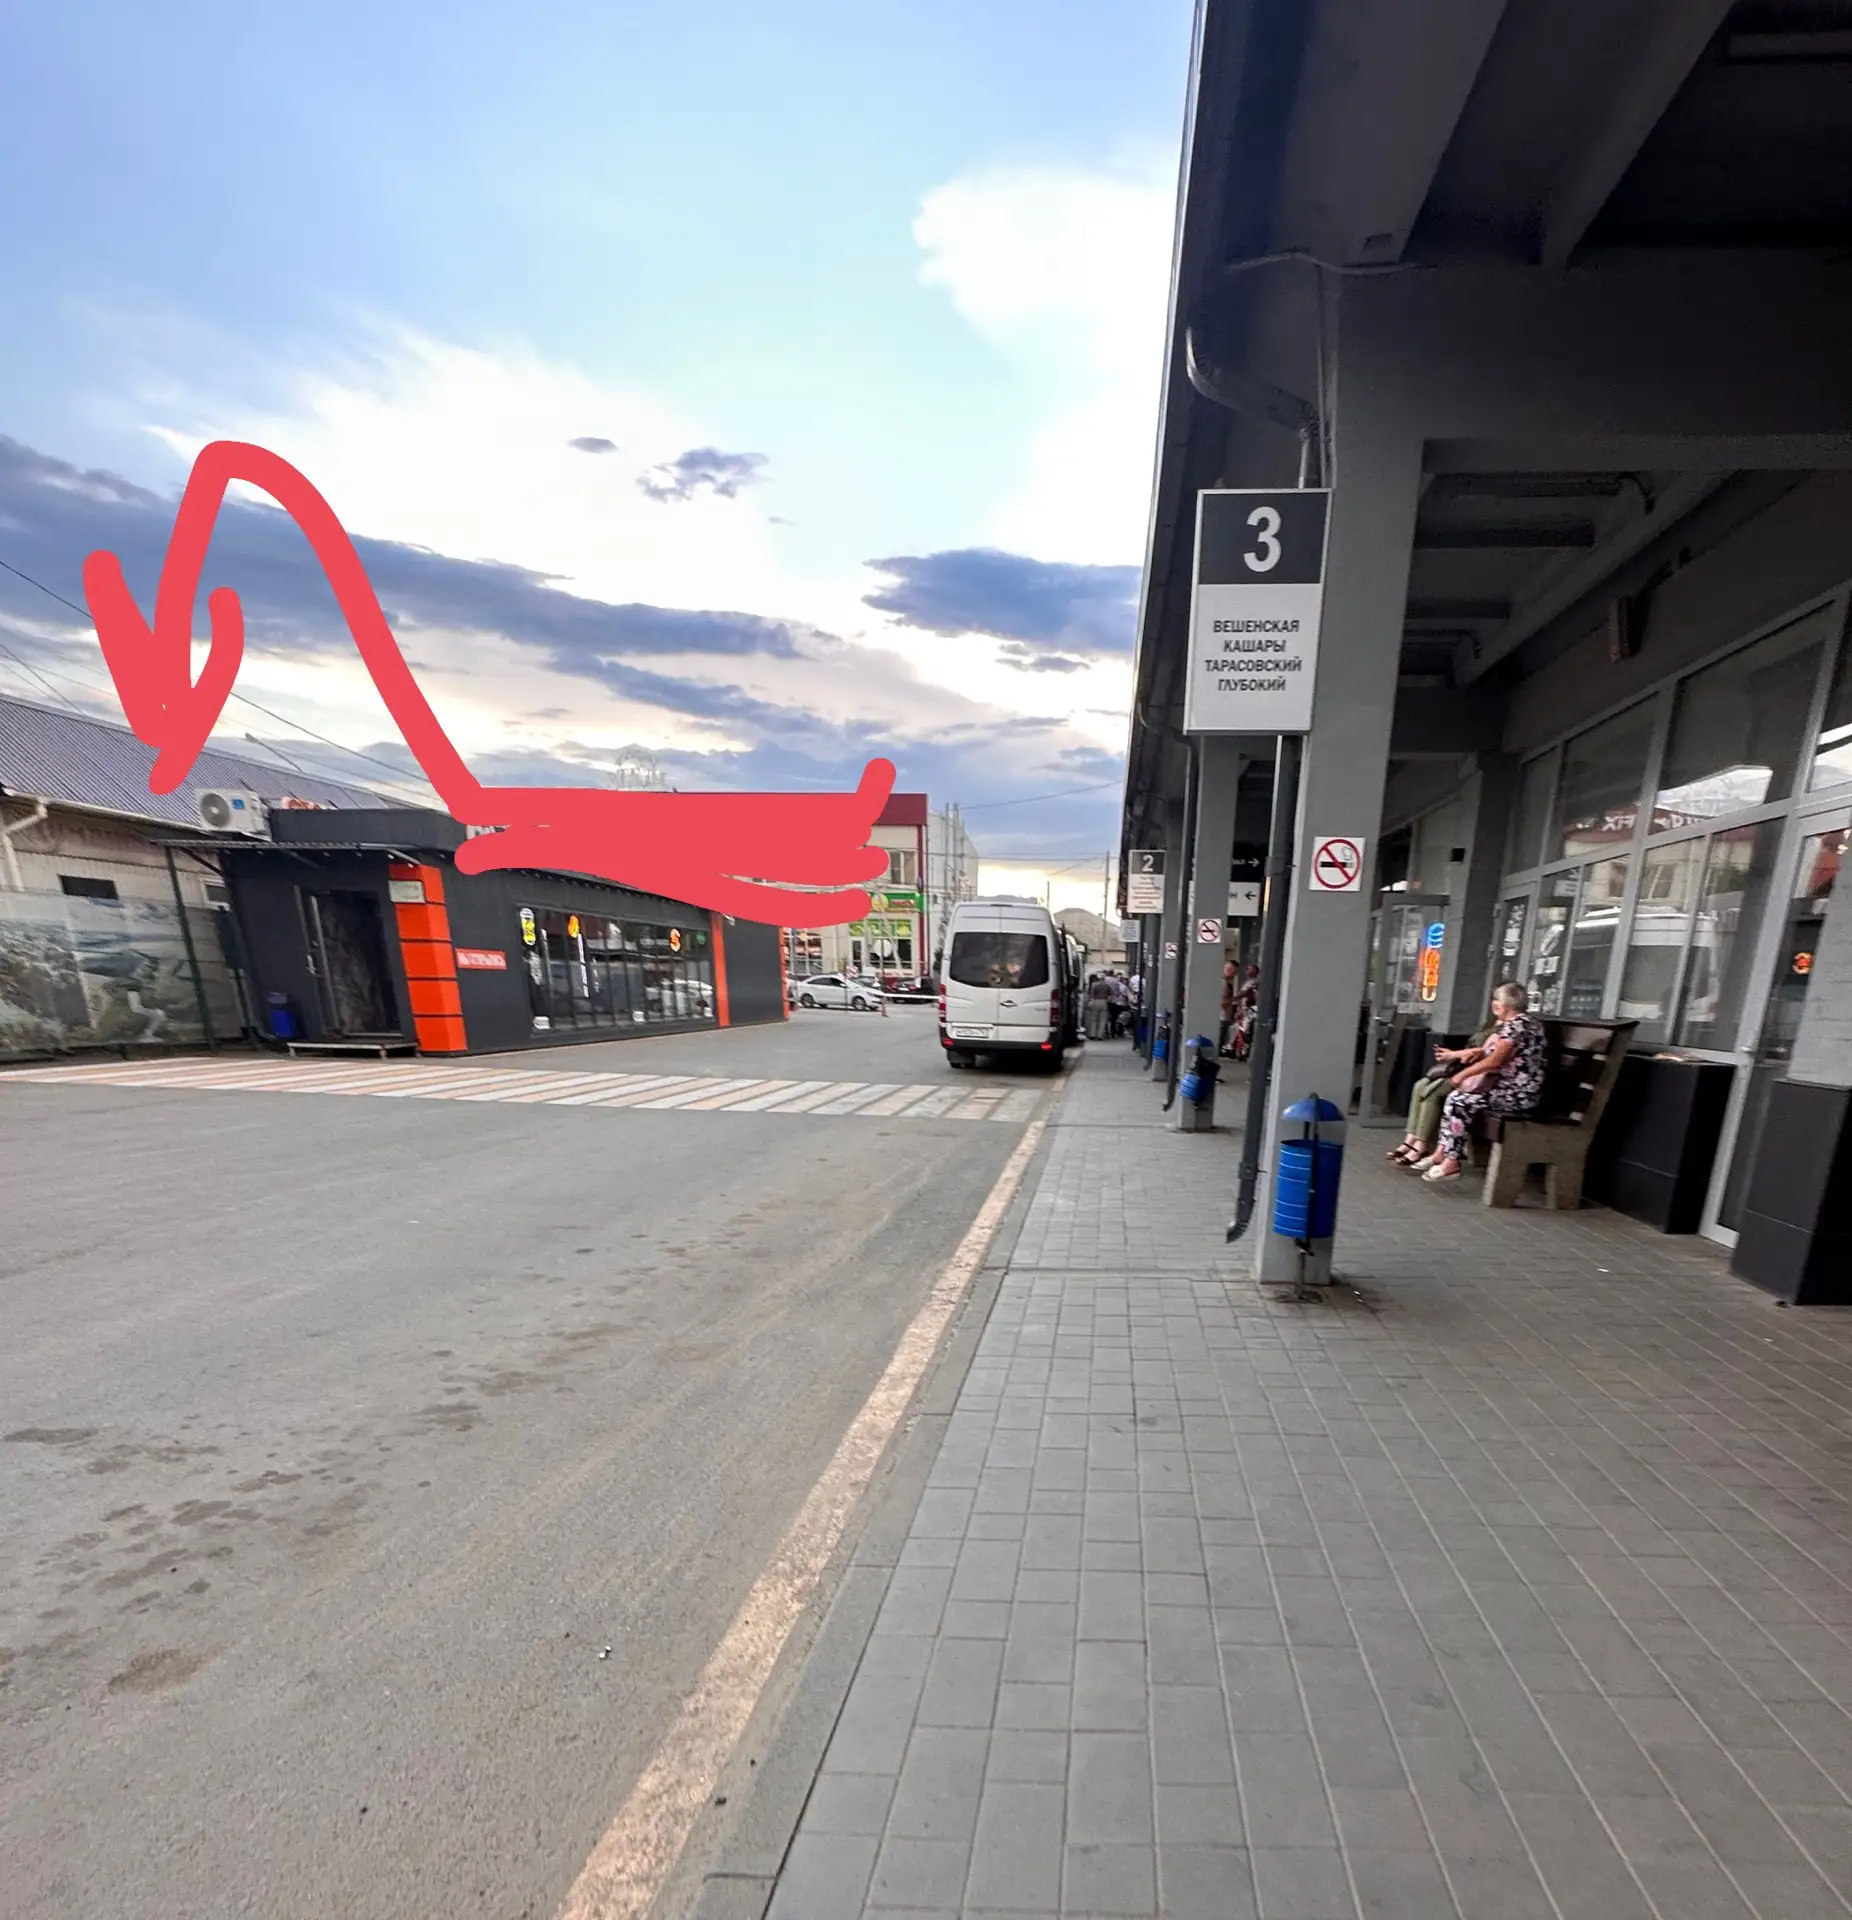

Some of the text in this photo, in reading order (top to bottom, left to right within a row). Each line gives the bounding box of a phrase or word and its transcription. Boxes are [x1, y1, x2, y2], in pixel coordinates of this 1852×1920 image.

[1243, 506, 1282, 573] 3
[1213, 620, 1300, 633] ВЕШЕНСКАЯ
[1223, 639, 1287, 652] КАШАРЫ
[1204, 656, 1302, 672] ТАРАСОВСКИЙ
[1217, 676, 1286, 692] ГЛУБОКИЙ
[1142, 854, 1154, 872] 2
